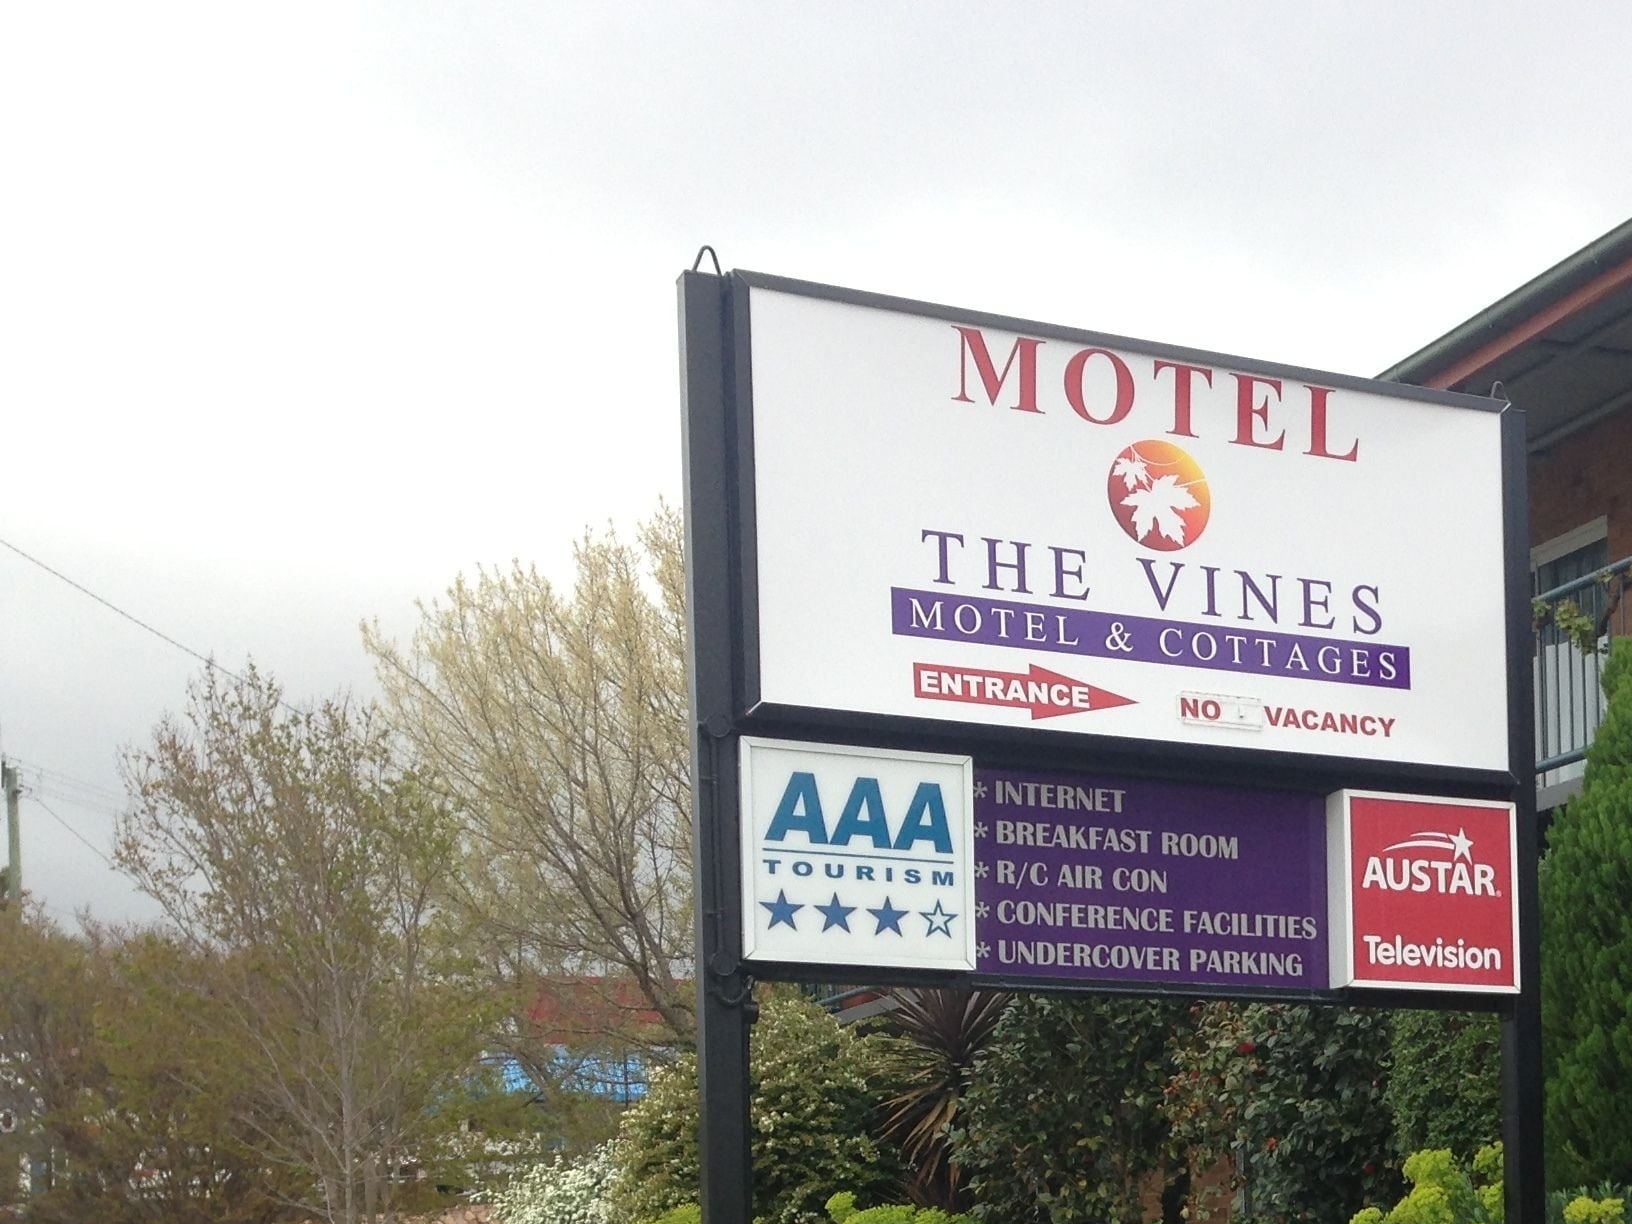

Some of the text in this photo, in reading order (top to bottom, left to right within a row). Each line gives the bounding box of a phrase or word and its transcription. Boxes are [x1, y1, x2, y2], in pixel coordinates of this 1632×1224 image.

[951, 325, 1359, 462] MOTEL
[921, 529, 1383, 635] THE VINES
[909, 598, 1398, 680] MOTEL & COTTAGES
[919, 670, 1091, 709] ENTRANCE
[1180, 697, 1396, 738] NO VACANCY
[764, 771, 954, 854] AAA
[995, 780, 1126, 813] INTERNET
[996, 820, 1239, 860] BREAKFAST ROOM
[762, 859, 954, 886] TOURISM
[997, 860, 1168, 894] R/C AIR CON
[1362, 856, 1497, 897] AUSTAR
[997, 900, 1318, 940] CONFERENCE FACILITIES
[998, 940, 1303, 977] UNDERCOVER PARKING
[1363, 935, 1501, 970] Television
